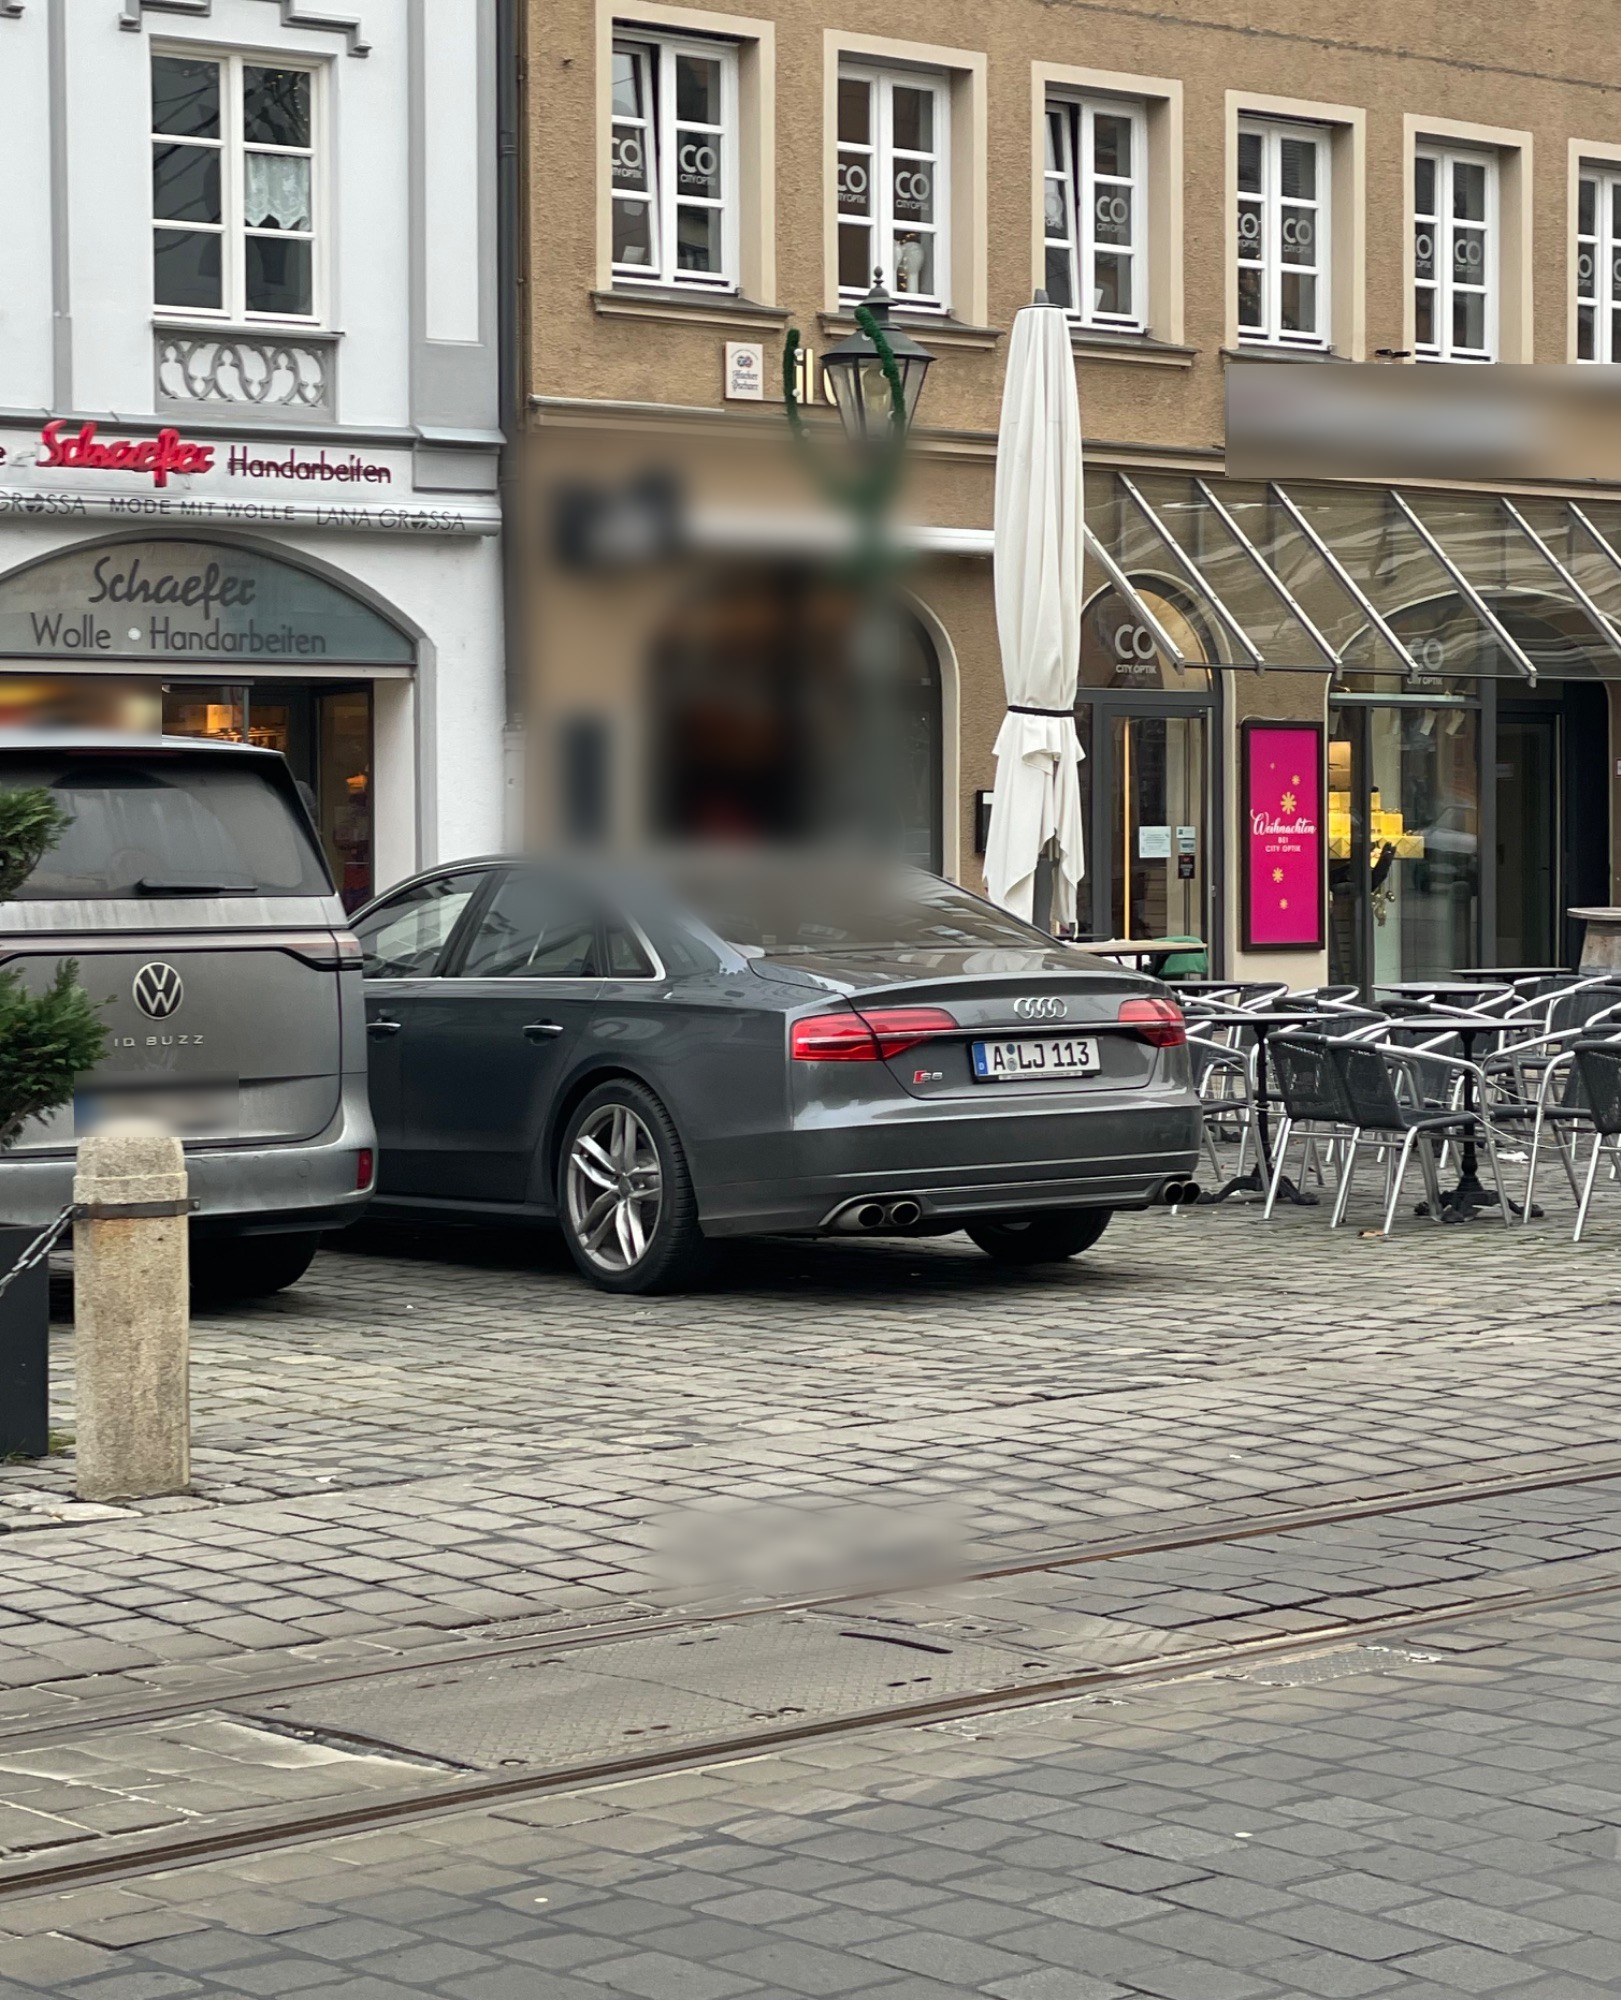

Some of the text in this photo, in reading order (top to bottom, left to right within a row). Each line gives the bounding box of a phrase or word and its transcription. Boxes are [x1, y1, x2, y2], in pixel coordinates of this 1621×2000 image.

[680, 144, 717, 175] CO
[895, 171, 930, 200] CO
[1096, 196, 1128, 223] CO
[1283, 218, 1312, 245] CO
[1455, 239, 1481, 265] CO
[35, 420, 392, 487] Schaefer Handarbeiten
[109, 497, 171, 515] MODE
[181, 501, 216, 517] MIT
[225, 503, 295, 521] WOLLE
[316, 506, 372, 526] LANA
[88, 556, 256, 620] Schaefer
[30, 612, 326, 653] Wolle Handarbeiten
[1115, 624, 1157, 659] CO
[1115, 664, 1157, 674] CITY OPTIK
[1250, 809, 1317, 835] Weihnachten
[1265, 845, 1301, 853] CITY OPTIK
[146, 1034, 204, 1046] BUZZ
[1051, 1041, 1089, 1067] 113
